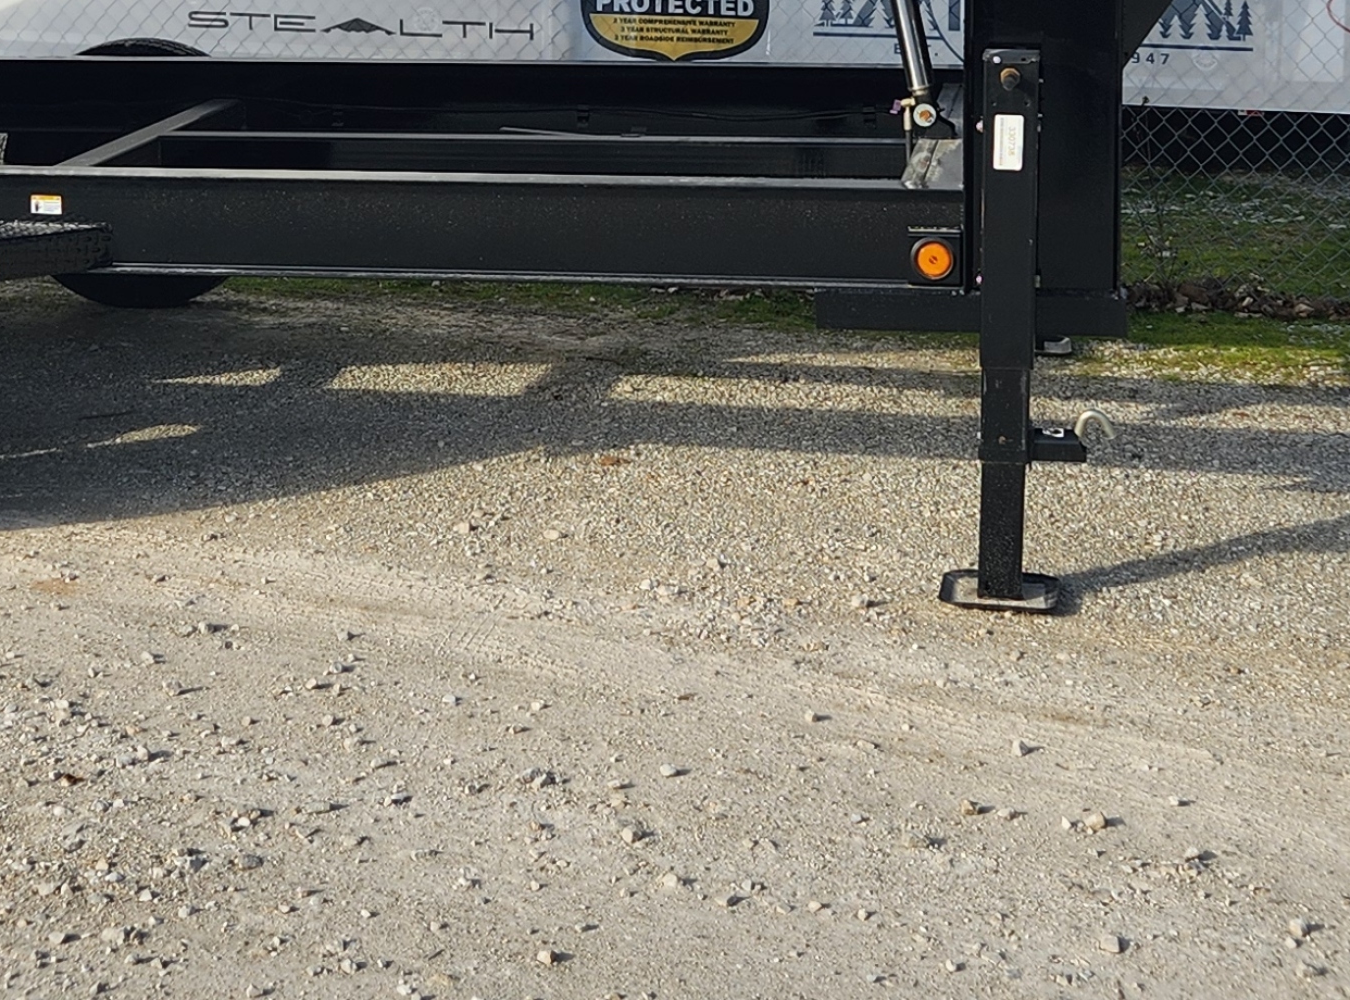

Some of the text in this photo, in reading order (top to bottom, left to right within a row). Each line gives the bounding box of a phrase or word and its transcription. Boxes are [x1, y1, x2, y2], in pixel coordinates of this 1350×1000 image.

[187, 11, 535, 40] STEALTH
[638, 18, 697, 26] COMPREHENSIVE
[691, 28, 728, 36] WARRANTY
[676, 36, 735, 44] REIMBURSEMENT
[1131, 52, 1171, 66] 947
